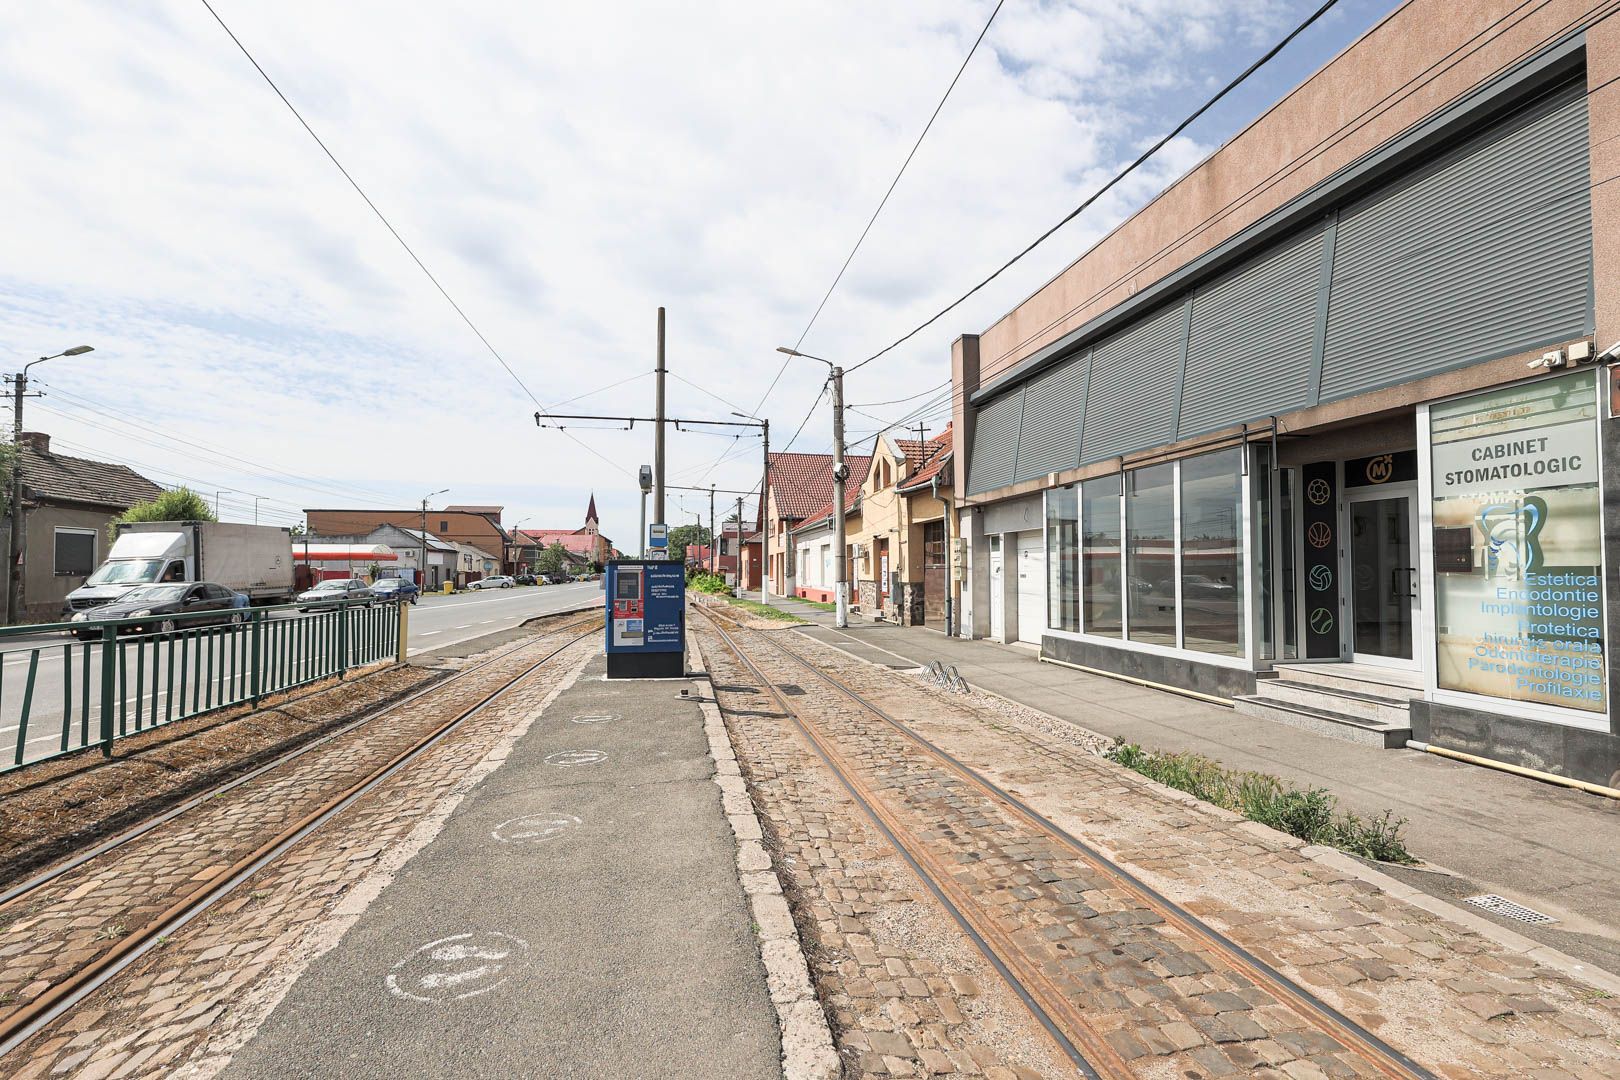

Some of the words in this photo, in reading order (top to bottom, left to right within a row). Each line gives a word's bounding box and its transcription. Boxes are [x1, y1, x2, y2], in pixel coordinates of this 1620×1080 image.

[1472, 437, 1548, 461] CABINET
[1445, 455, 1582, 485] STOMATOLOGIC
[1525, 572, 1598, 586] Estetica
[1496, 587, 1598, 602] Endodontie
[1481, 601, 1599, 620] Implantologie
[1518, 619, 1600, 639] Protetica
[1468, 657, 1601, 685] Parodontologie
[1516, 677, 1601, 701] Profilaxie
